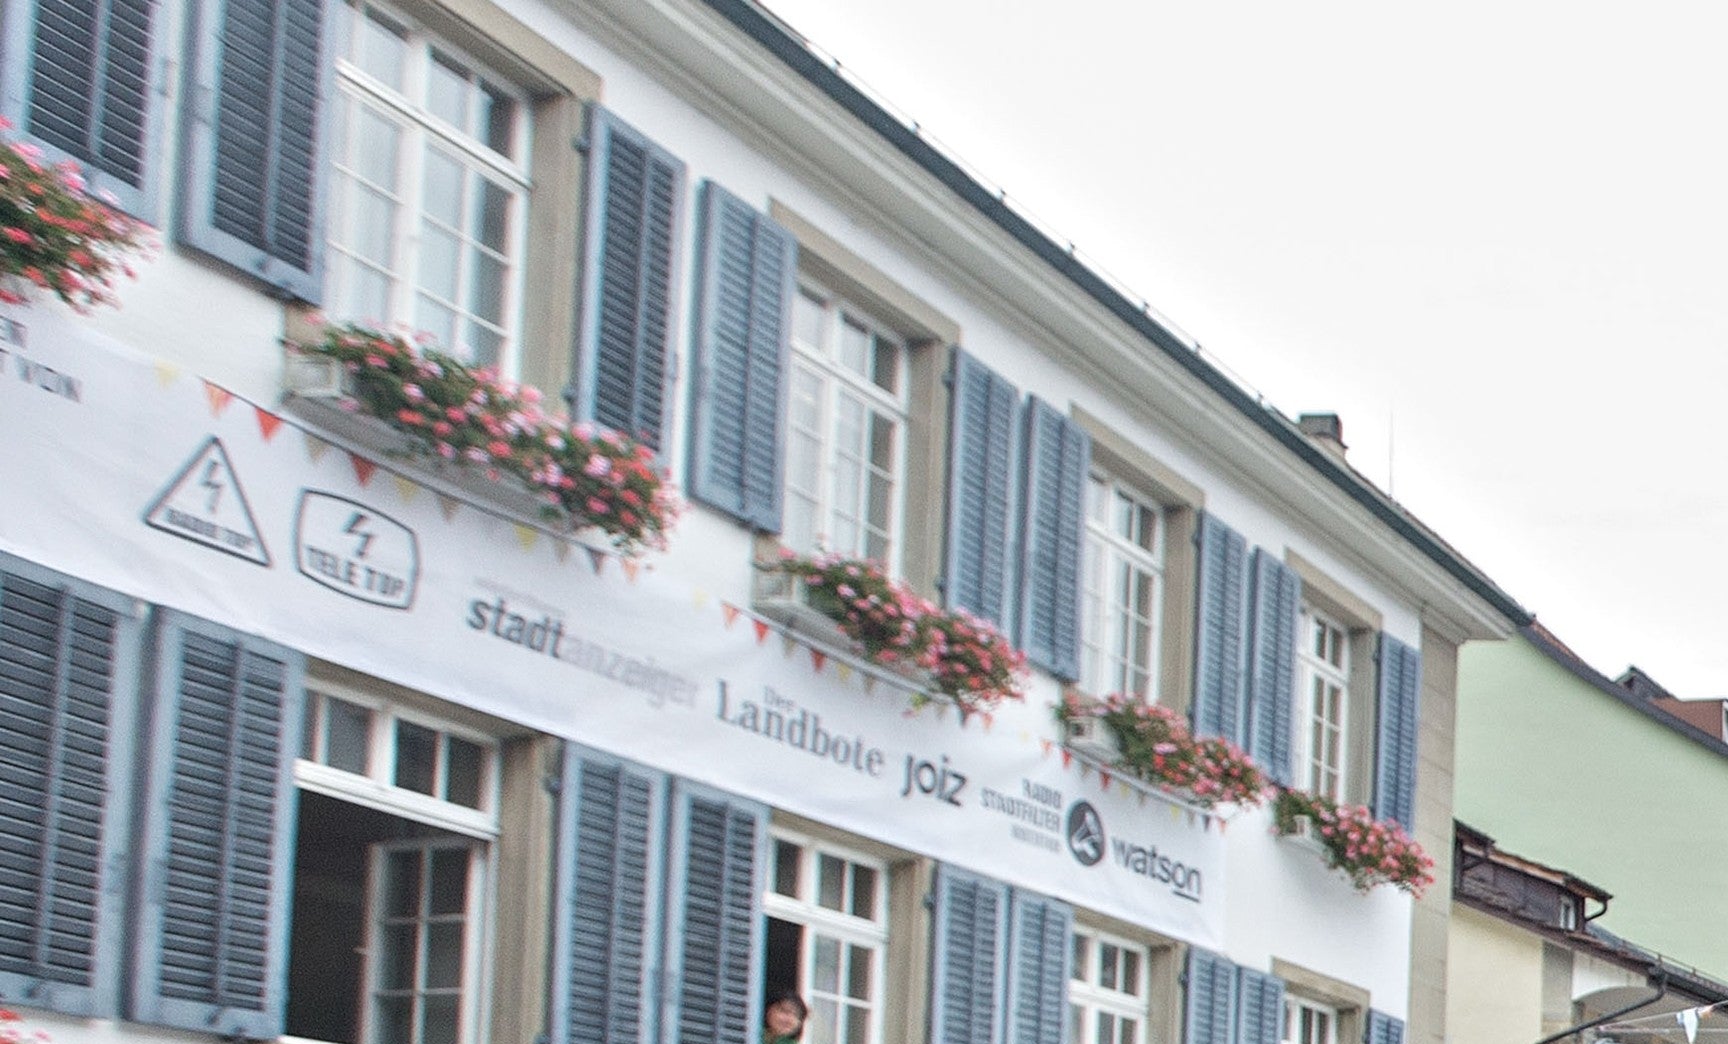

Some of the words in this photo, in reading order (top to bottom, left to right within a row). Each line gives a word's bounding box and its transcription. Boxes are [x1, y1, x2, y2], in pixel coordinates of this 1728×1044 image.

[304, 545, 357, 586] TELE
[363, 565, 405, 598] TOP
[716, 678, 886, 778] Landbote
[1111, 835, 1203, 899] watson
